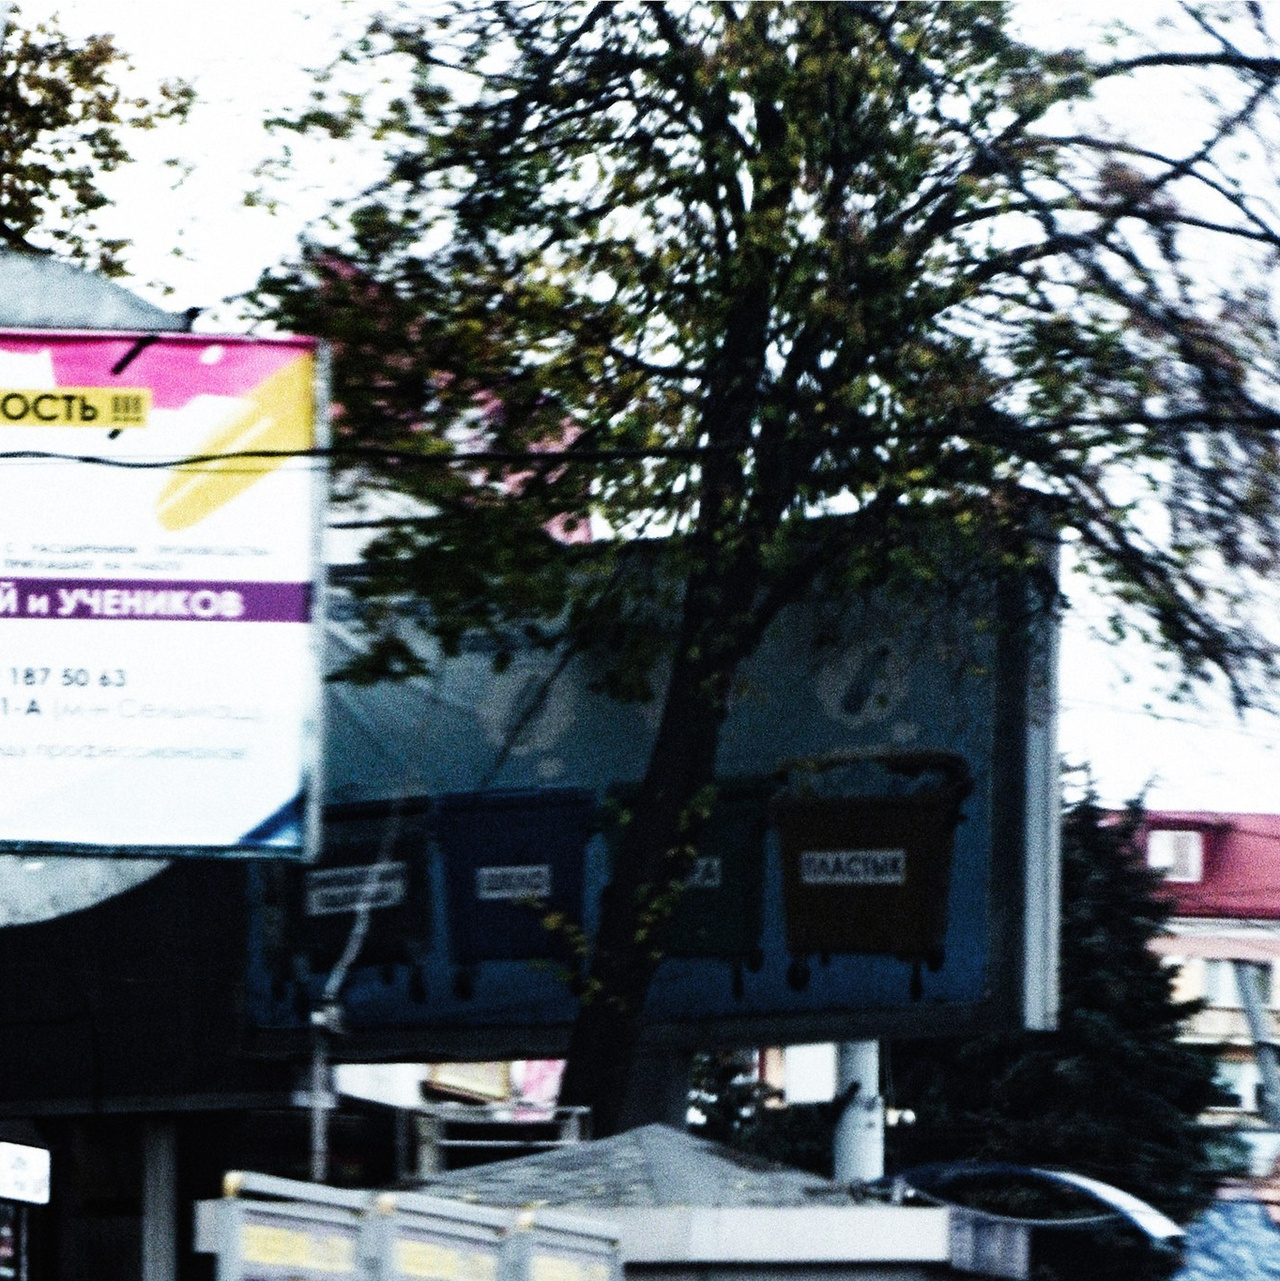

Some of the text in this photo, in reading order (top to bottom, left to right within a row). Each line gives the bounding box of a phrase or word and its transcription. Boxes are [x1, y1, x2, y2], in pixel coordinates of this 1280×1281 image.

[28, 593, 49, 614] и
[57, 589, 245, 618] УЧЕНИКОВ
[11, 666, 51, 686] 187
[62, 668, 89, 687] 50
[99, 669, 126, 687] 63
